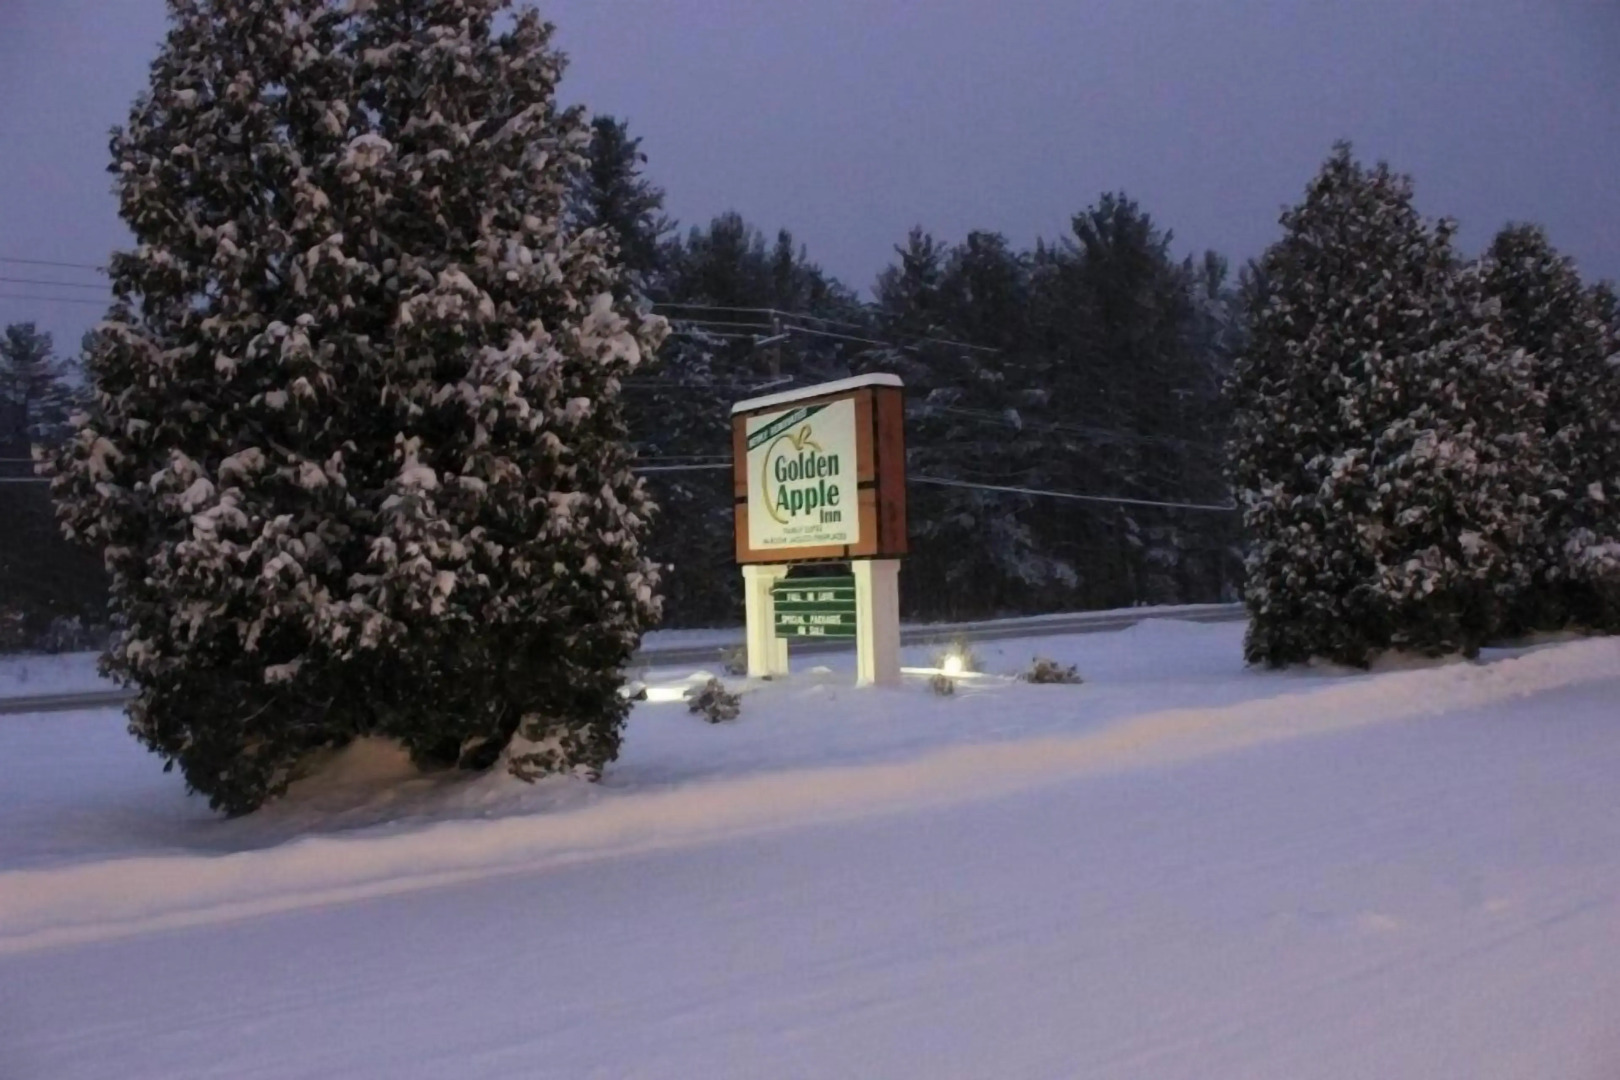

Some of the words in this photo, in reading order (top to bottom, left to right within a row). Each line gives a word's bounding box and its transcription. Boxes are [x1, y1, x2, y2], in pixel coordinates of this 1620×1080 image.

[775, 452, 839, 483] Golden
[776, 479, 839, 516] Apple
[820, 508, 841, 523] Inn
